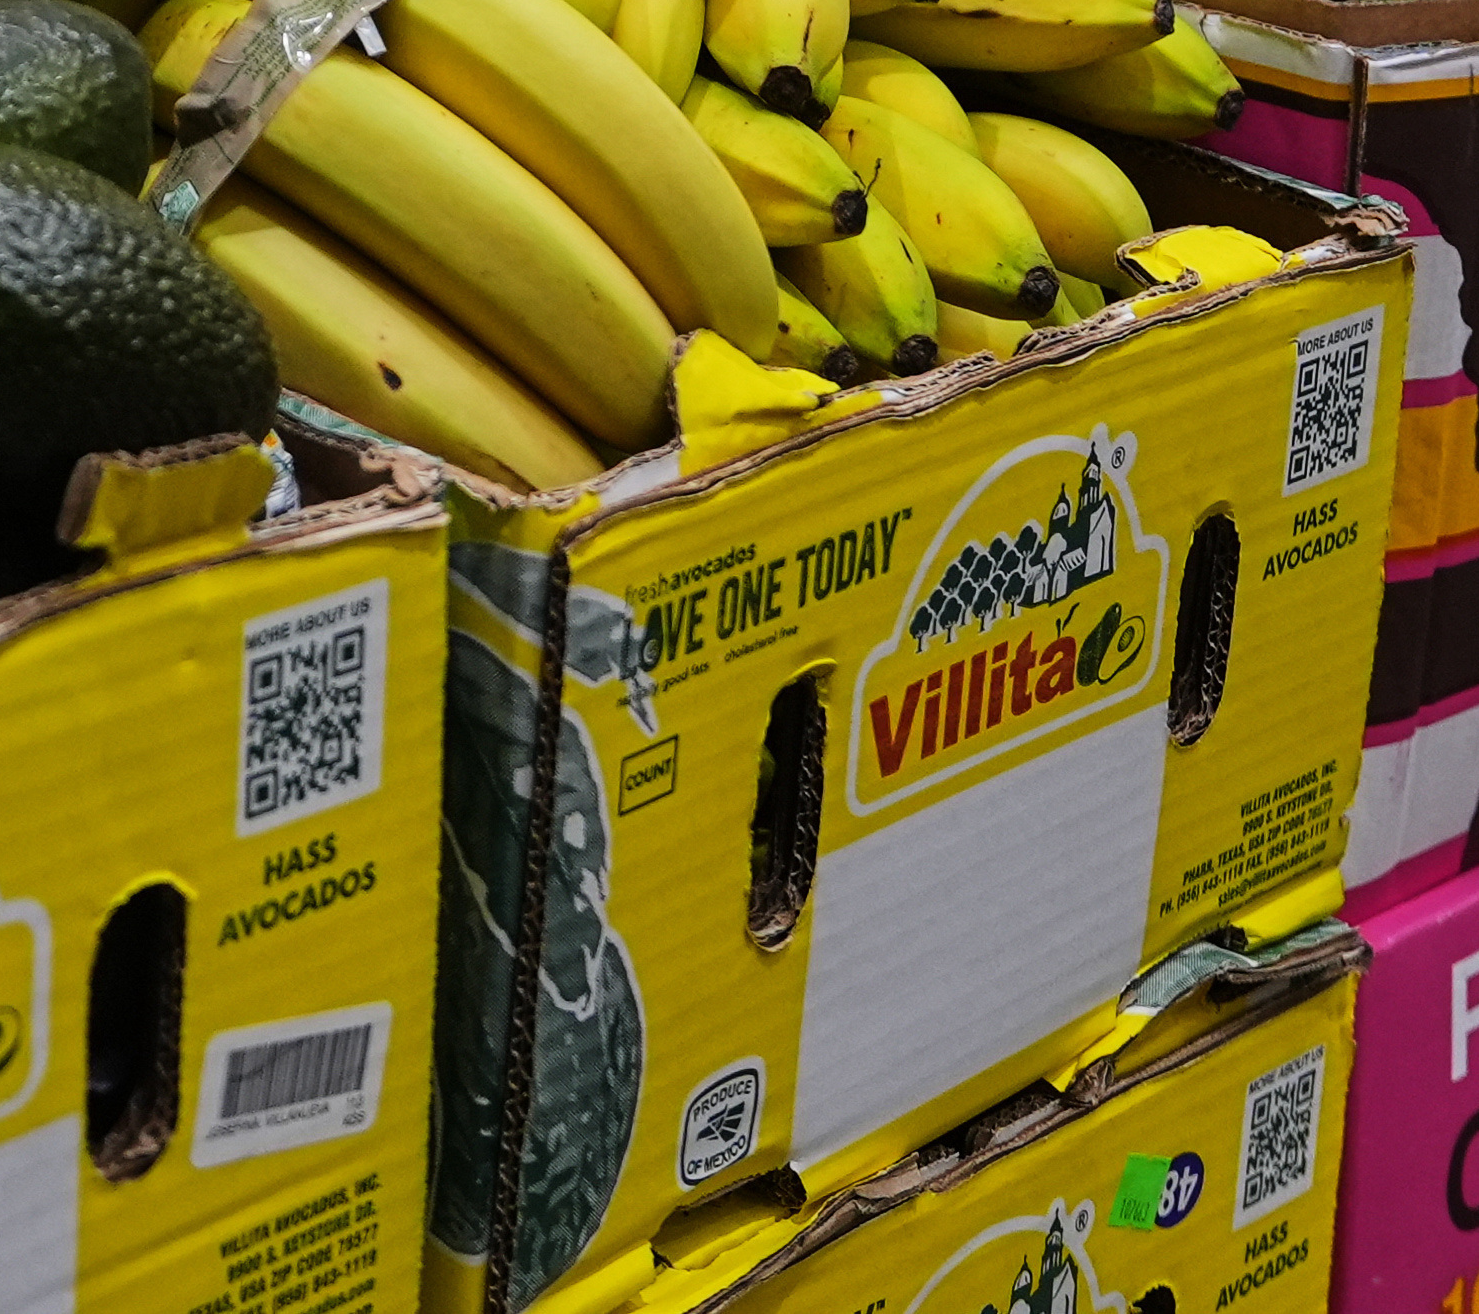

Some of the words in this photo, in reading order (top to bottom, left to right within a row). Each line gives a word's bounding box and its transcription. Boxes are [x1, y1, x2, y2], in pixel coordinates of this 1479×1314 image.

[1297, 334, 1326, 357] MORE
[1326, 323, 1359, 346] ABOUT
[1360, 317, 1374, 335] US
[1292, 497, 1339, 537] HASS
[1261, 521, 1360, 582] AVOCADOS
[245, 621, 291, 650] MORE
[294, 603, 345, 636] ABOUT
[350, 596, 372, 618] US
[619, 587, 708, 682] LOVE
[715, 556, 786, 641] ONE
[625, 756, 674, 792] COUNT
[1240, 791, 1272, 819] VILLITA
[1275, 787, 1319, 820] KEYSTONE
[1248, 834, 1266, 852] USA
[1267, 824, 1282, 844] ZIP
[1282, 810, 1306, 835] CODE
[263, 831, 337, 887] HASS
[217, 860, 377, 947] AVOCADOS
[1248, 1073, 1275, 1095] MORE
[1276, 1053, 1310, 1078] ABOUT
[693, 1079, 753, 1122] PRODUCE
[686, 1159, 702, 1176] OF
[703, 1134, 747, 1173] MEXICO
[1158, 1165, 1199, 1219] 48
[1244, 1220, 1289, 1264] HASS
[1215, 1237, 1309, 1313] AVOCADOS
